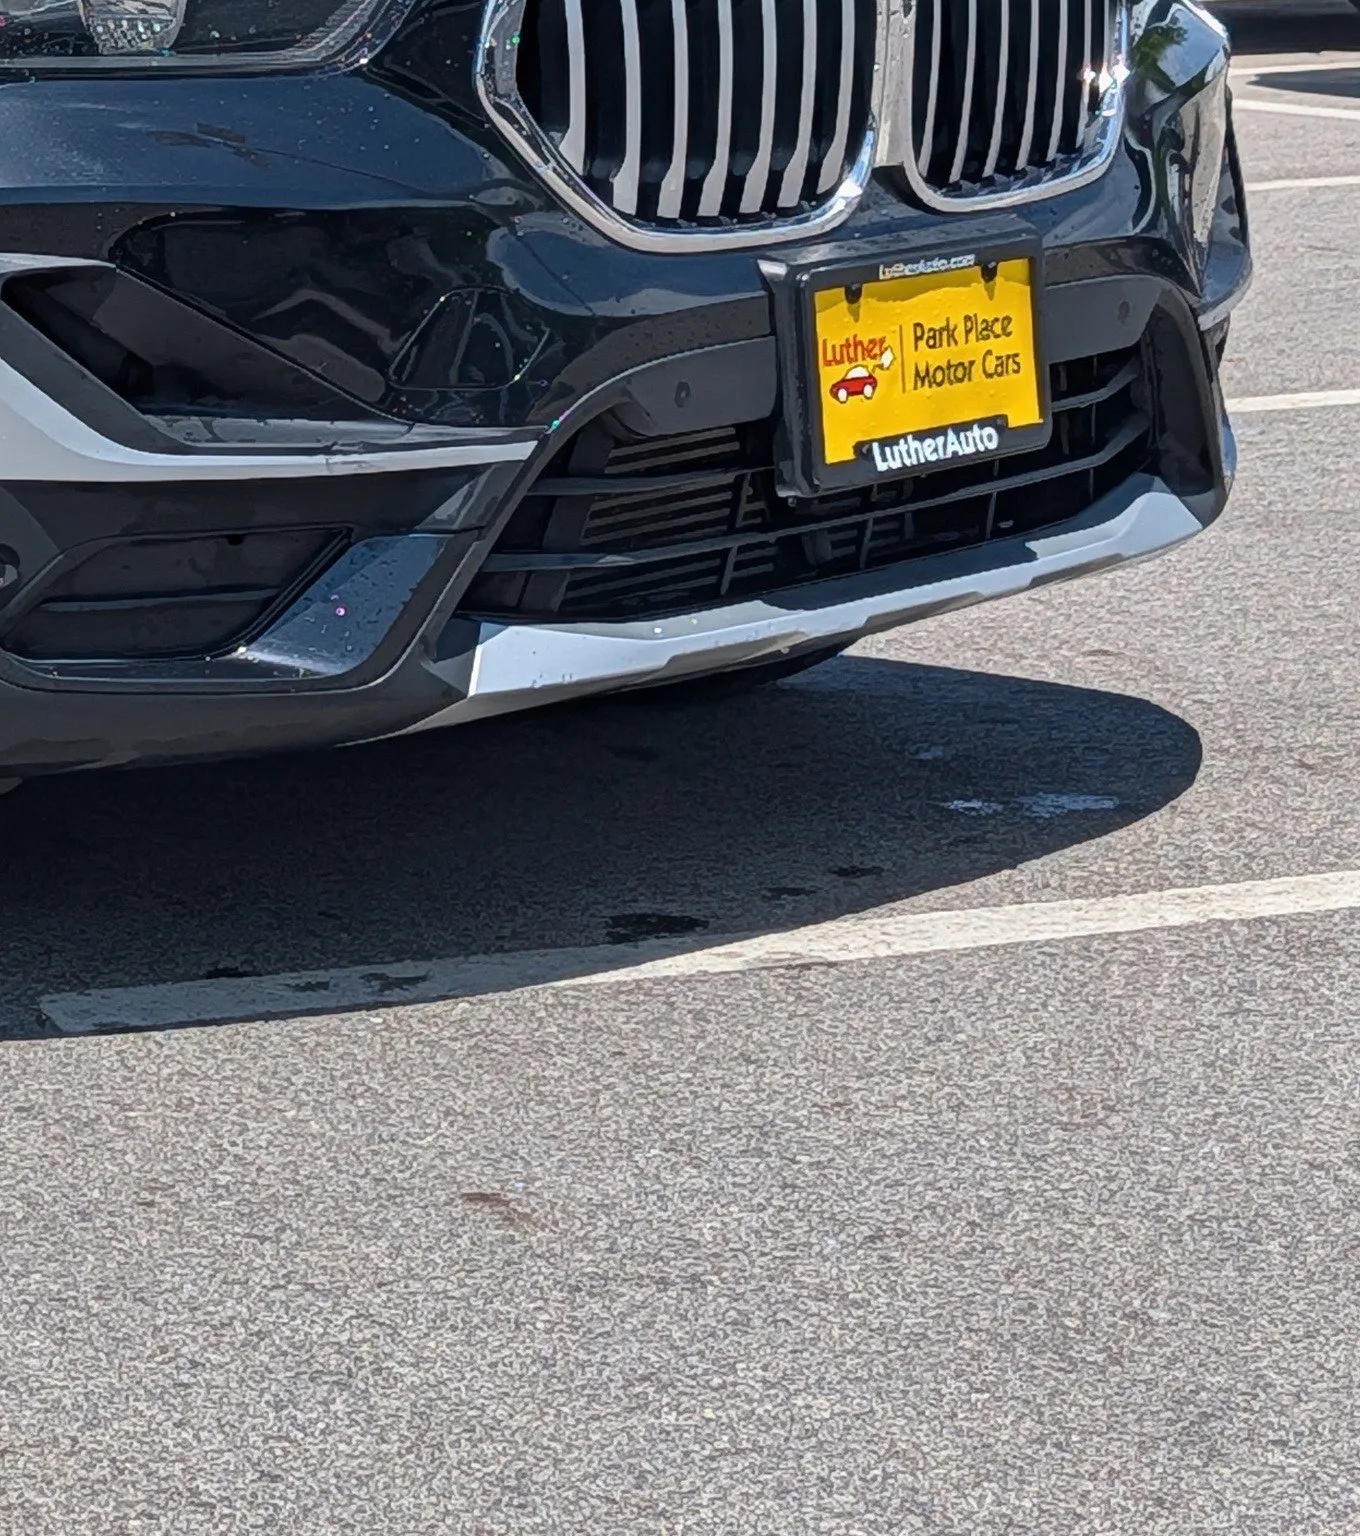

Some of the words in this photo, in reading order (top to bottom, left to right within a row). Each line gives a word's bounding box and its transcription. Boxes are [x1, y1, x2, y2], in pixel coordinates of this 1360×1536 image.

[822, 333, 887, 367] Luther
[912, 317, 958, 352] Park
[964, 313, 1013, 345] Place
[912, 358, 976, 390] Motor
[981, 350, 1021, 380] Cars
[872, 423, 1000, 472] LutherAuto
